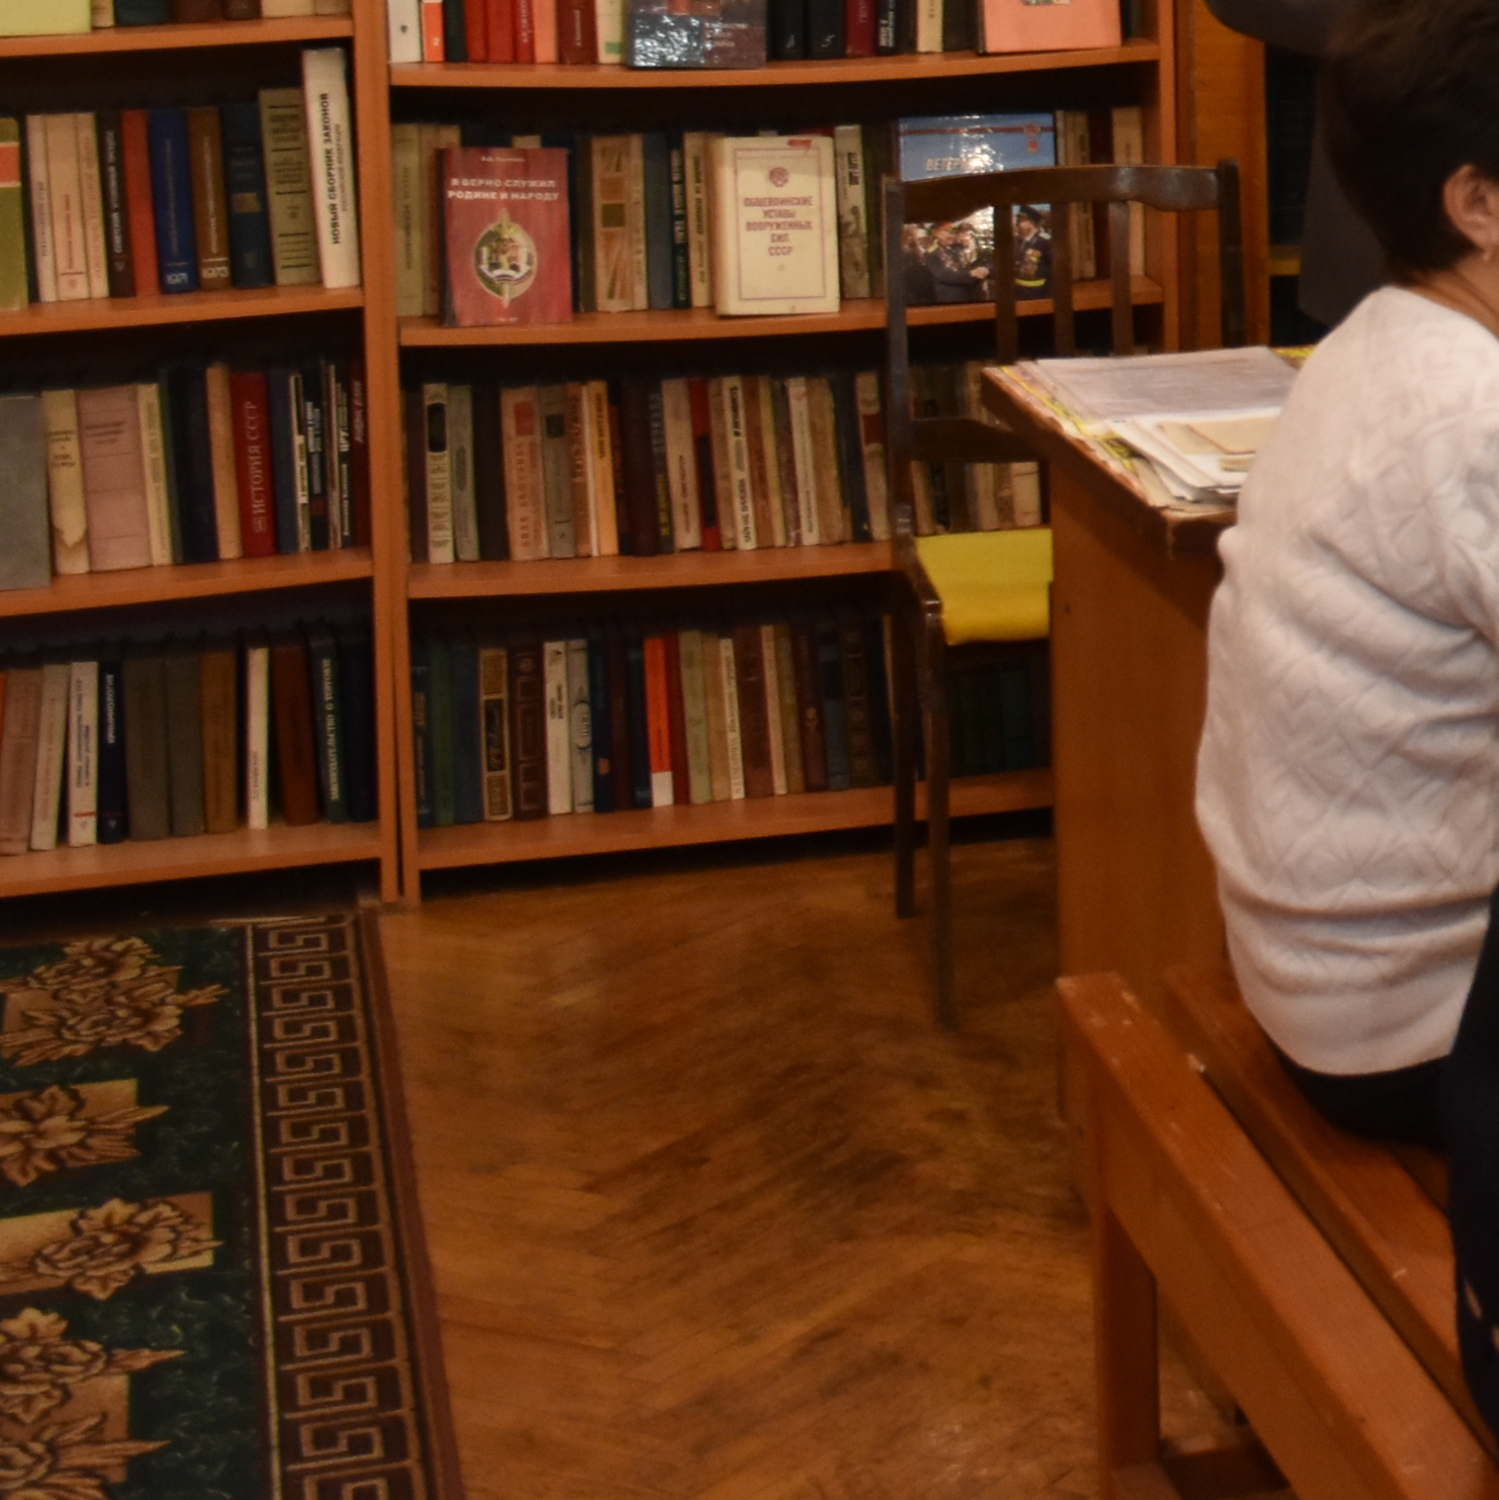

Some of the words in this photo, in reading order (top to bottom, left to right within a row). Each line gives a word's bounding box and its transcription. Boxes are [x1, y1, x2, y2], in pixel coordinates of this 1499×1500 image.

[319, 93, 333, 145] ЗАКОНОВ
[324, 147, 338, 202] СБОРНИК
[450, 178, 459, 187] Я
[504, 178, 557, 188] СЛУЖИЛ
[447, 190, 498, 200] РОДИНЕ
[510, 191, 560, 202] НАРОДУ
[328, 204, 341, 246] НОВЫЙ
[768, 245, 794, 257] СССР
[245, 400, 257, 440] СССР
[249, 444, 269, 514] ИСТОРИЯ
